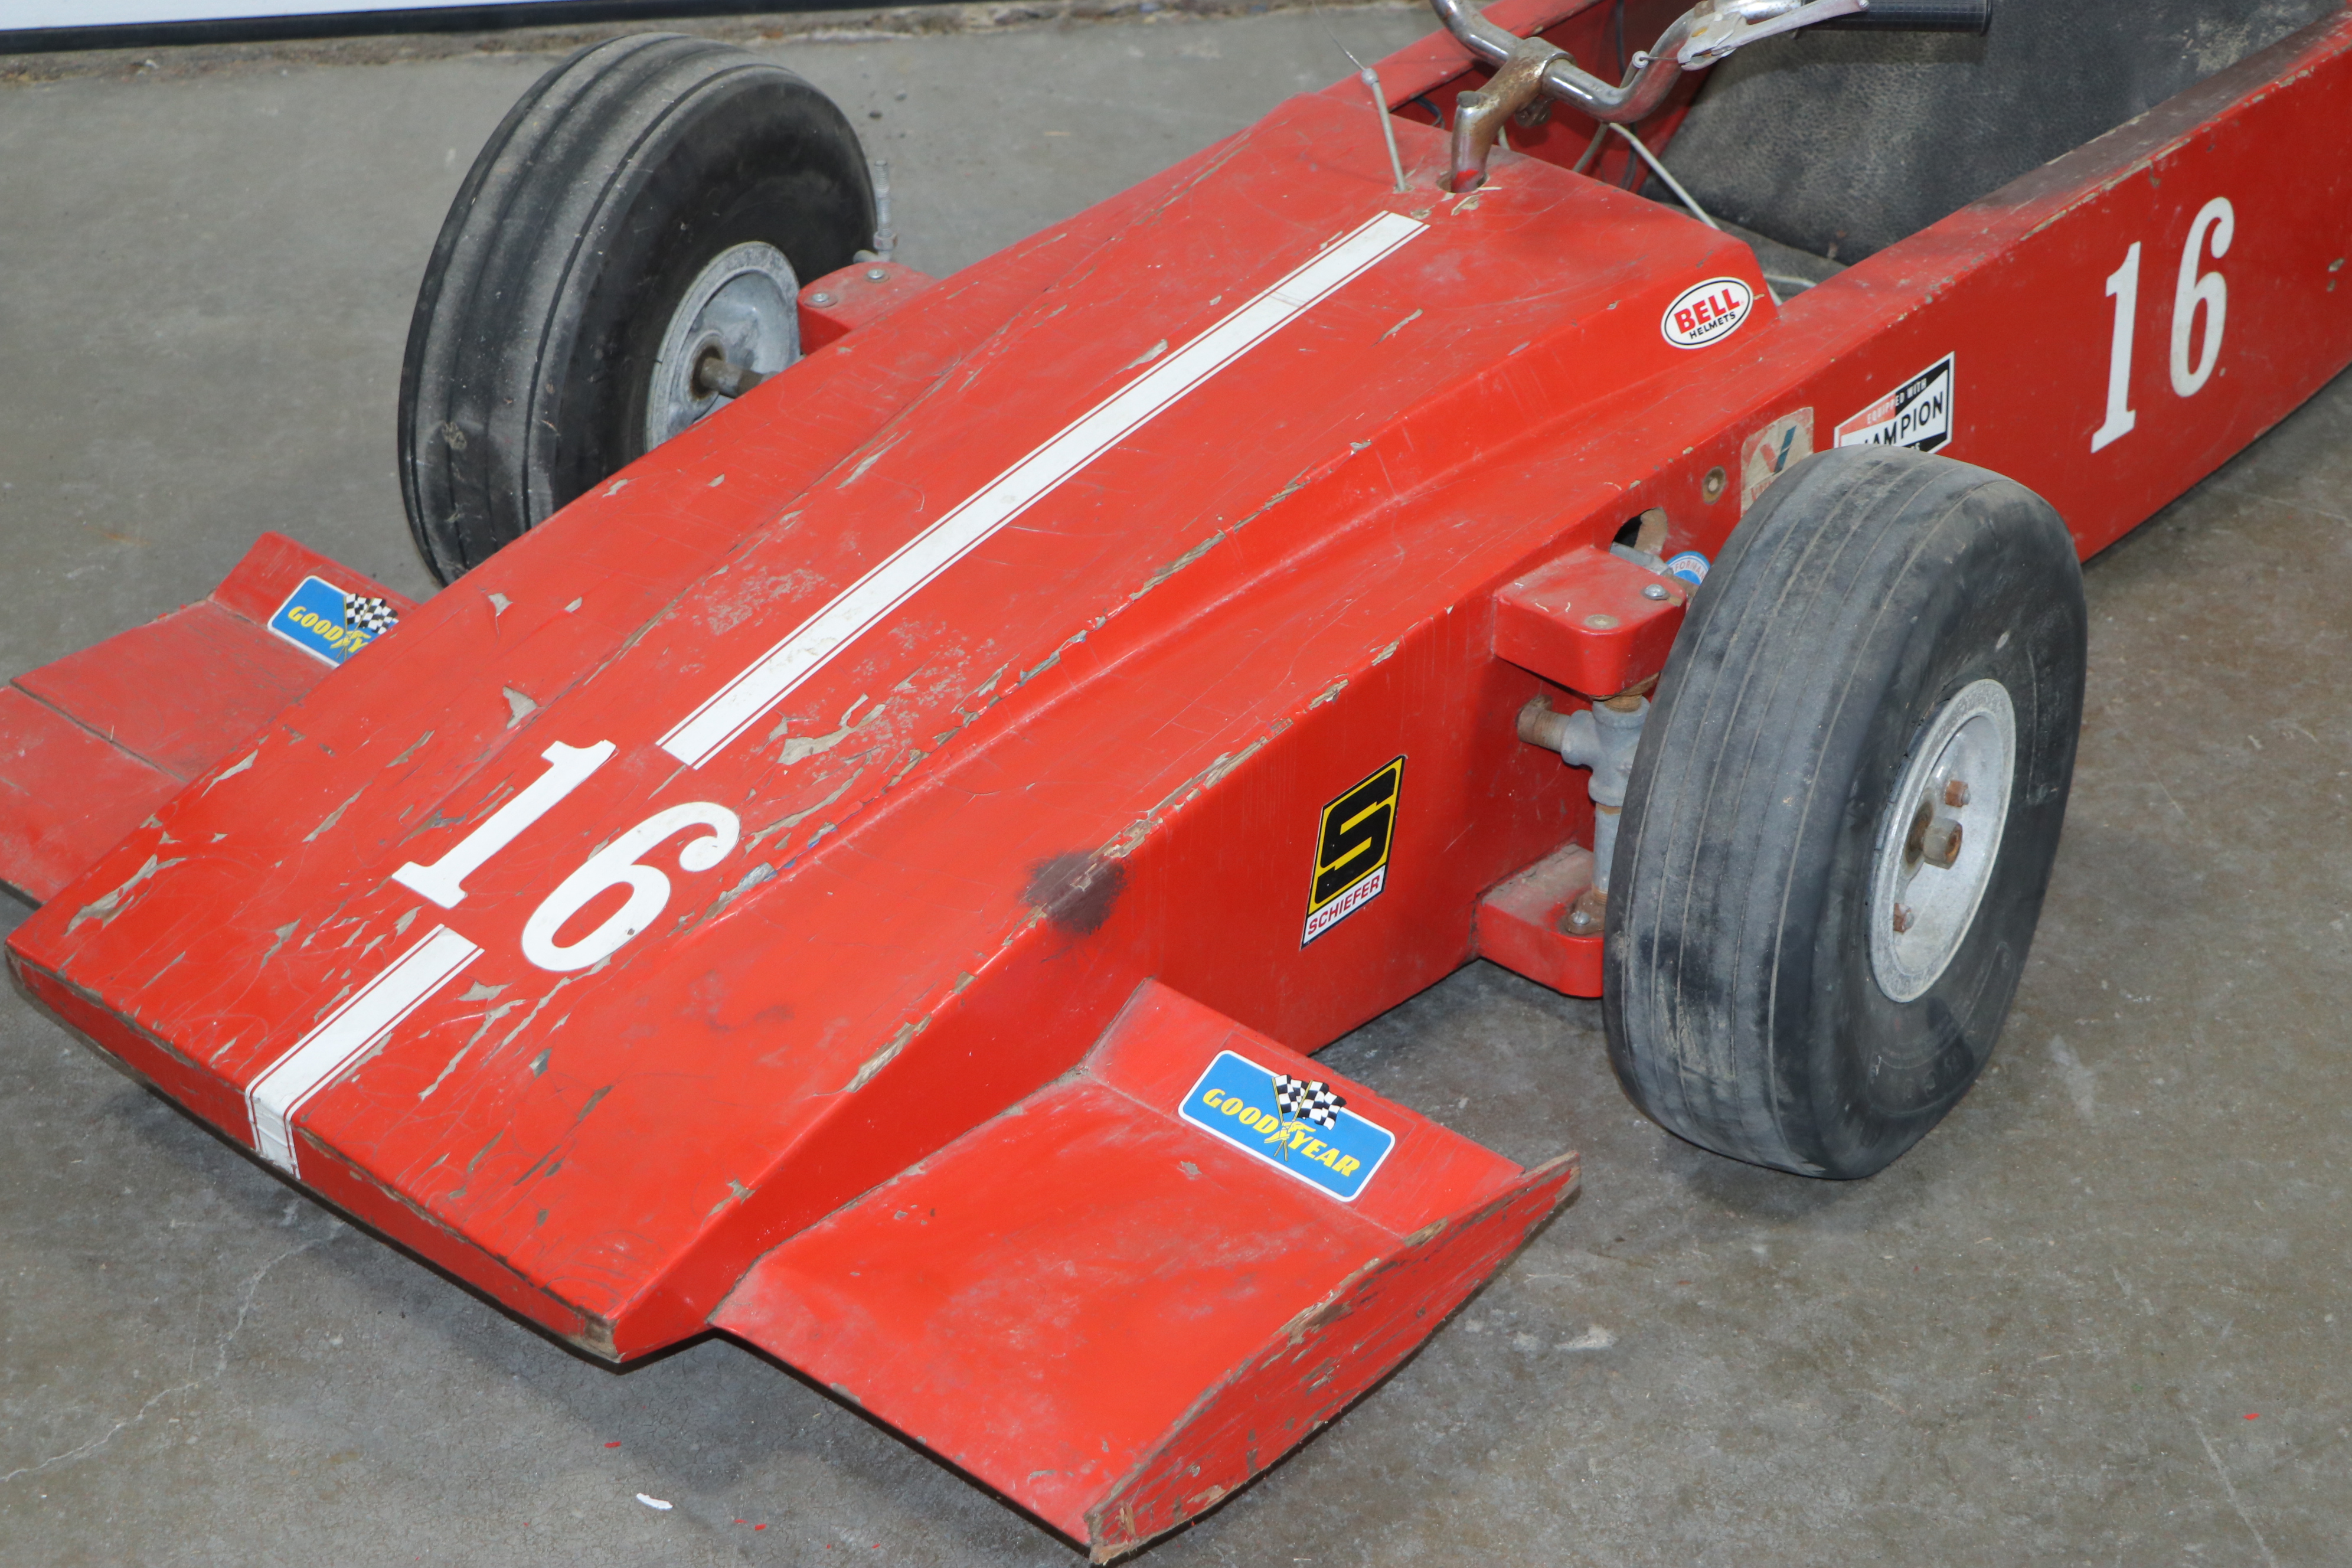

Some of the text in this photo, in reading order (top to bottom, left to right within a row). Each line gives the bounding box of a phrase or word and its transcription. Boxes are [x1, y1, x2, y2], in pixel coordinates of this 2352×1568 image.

[1674, 288, 1740, 334] BELL
[1689, 311, 1736, 339] HELMETS
[2090, 196, 2235, 453] 16
[1864, 390, 1943, 446] AMPION
[1867, 378, 1927, 424] EQUIPPED WITH
[1671, 560, 1706, 580] FORMAN
[288, 606, 369, 653] GOODY
[391, 739, 740, 972] 16
[1314, 767, 1397, 904] S
[1308, 875, 1380, 935] SCHIEFER
